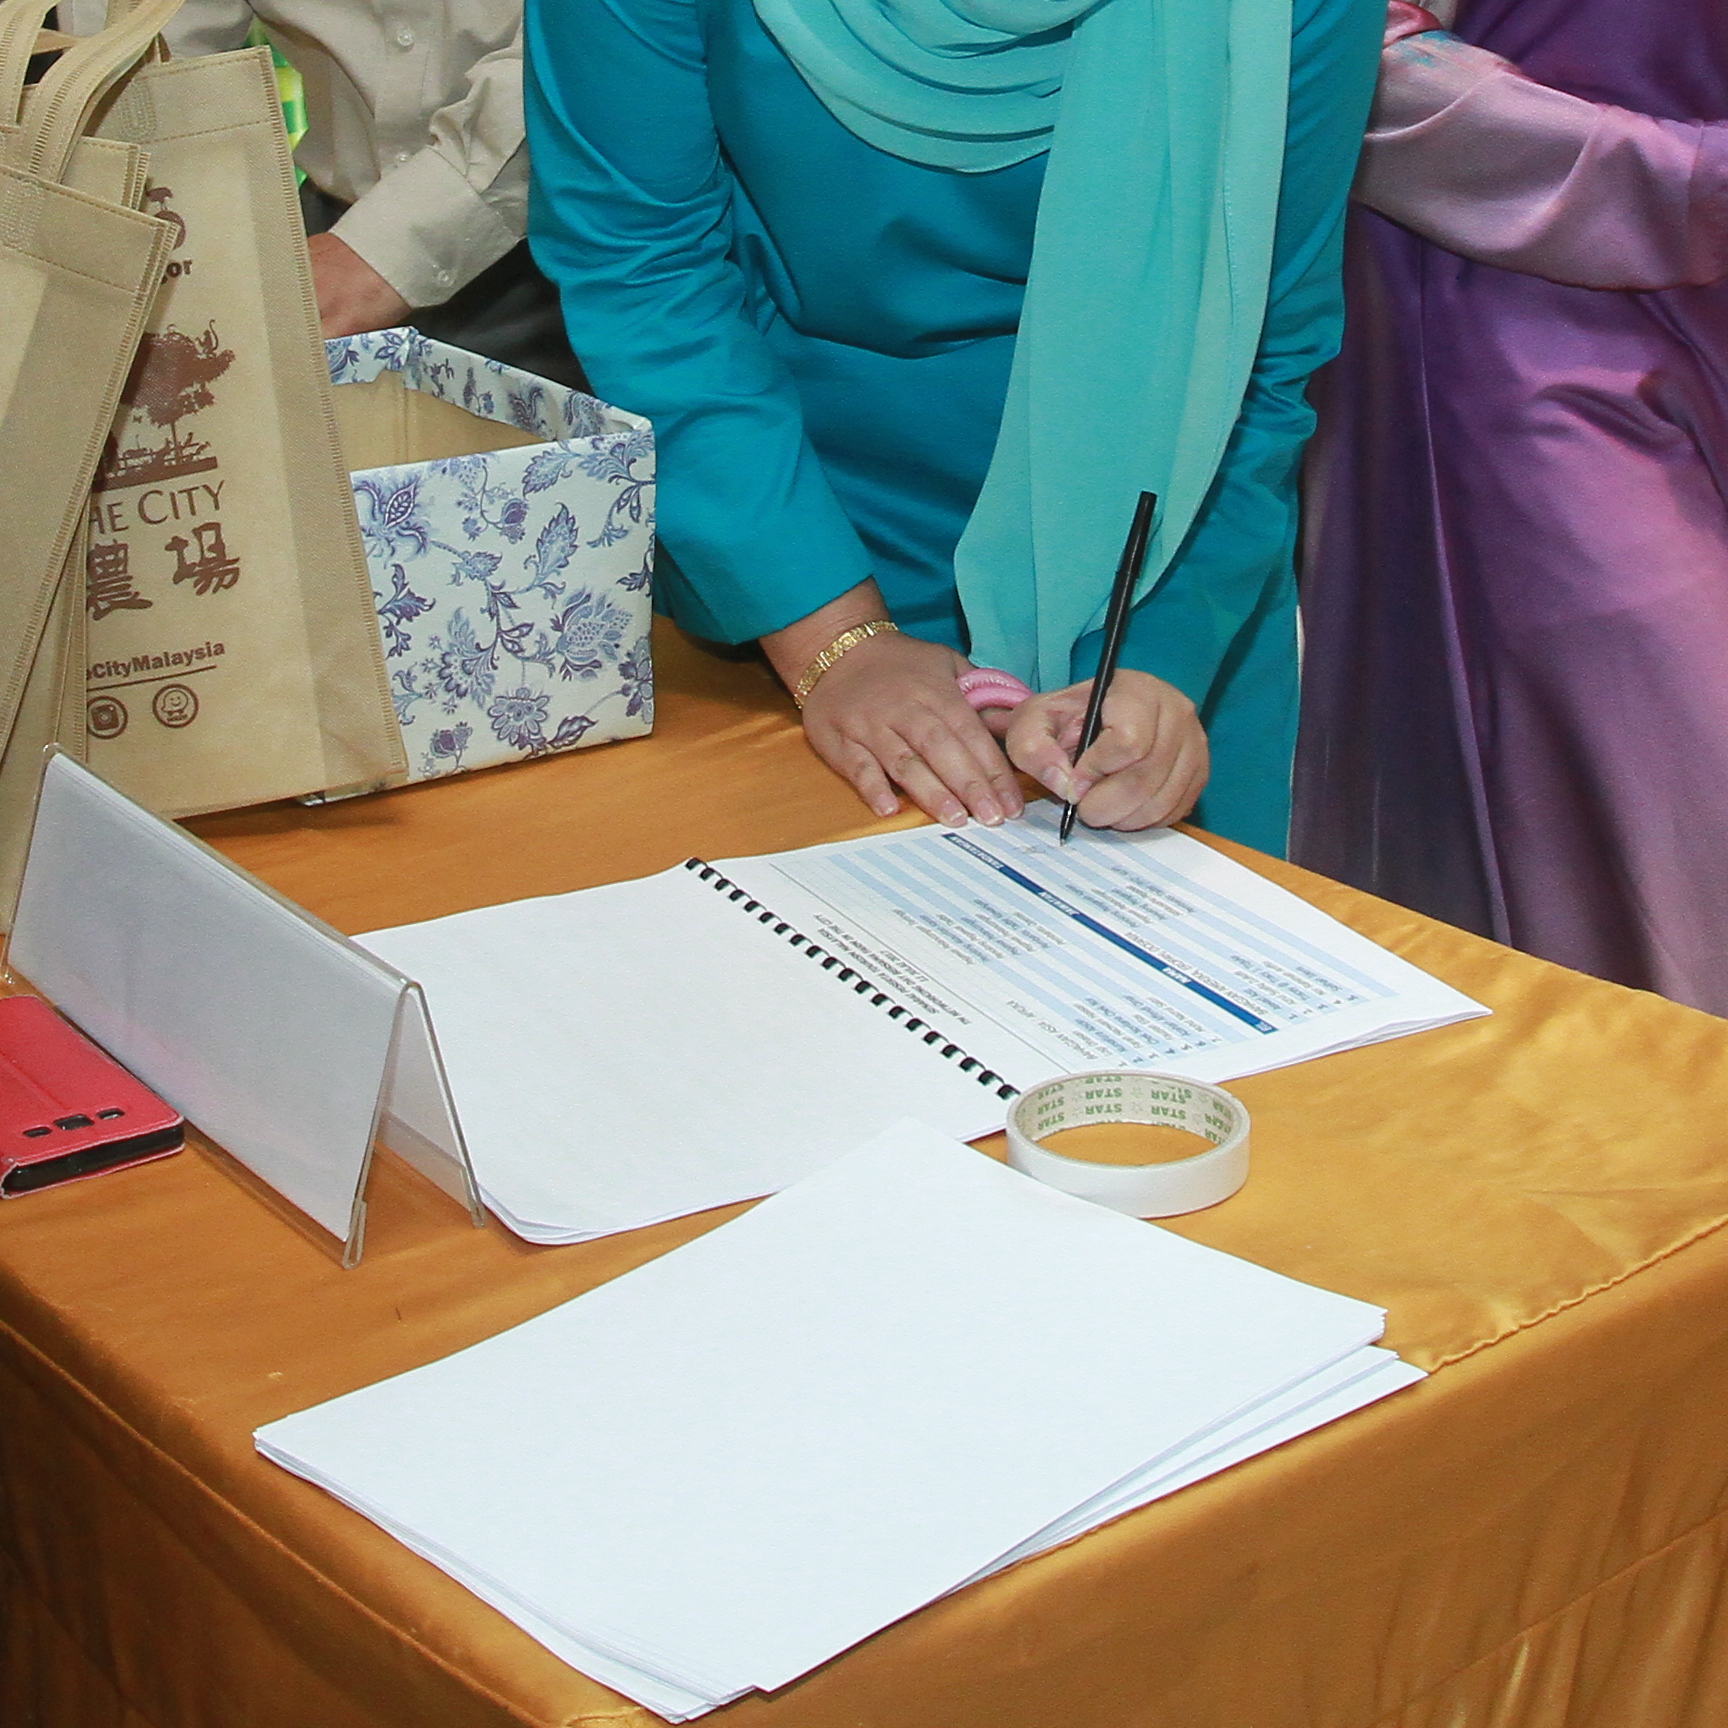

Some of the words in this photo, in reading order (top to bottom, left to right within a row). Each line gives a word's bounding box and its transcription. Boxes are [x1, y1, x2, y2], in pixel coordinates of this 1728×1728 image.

[89, 502, 130, 534] HE
[138, 480, 226, 524] CITY
[86, 641, 226, 681] CityMalaysia
[1085, 1088, 1122, 1100] STAR
[1086, 1104, 1122, 1115] STAR
[1151, 1106, 1187, 1120] STAR
